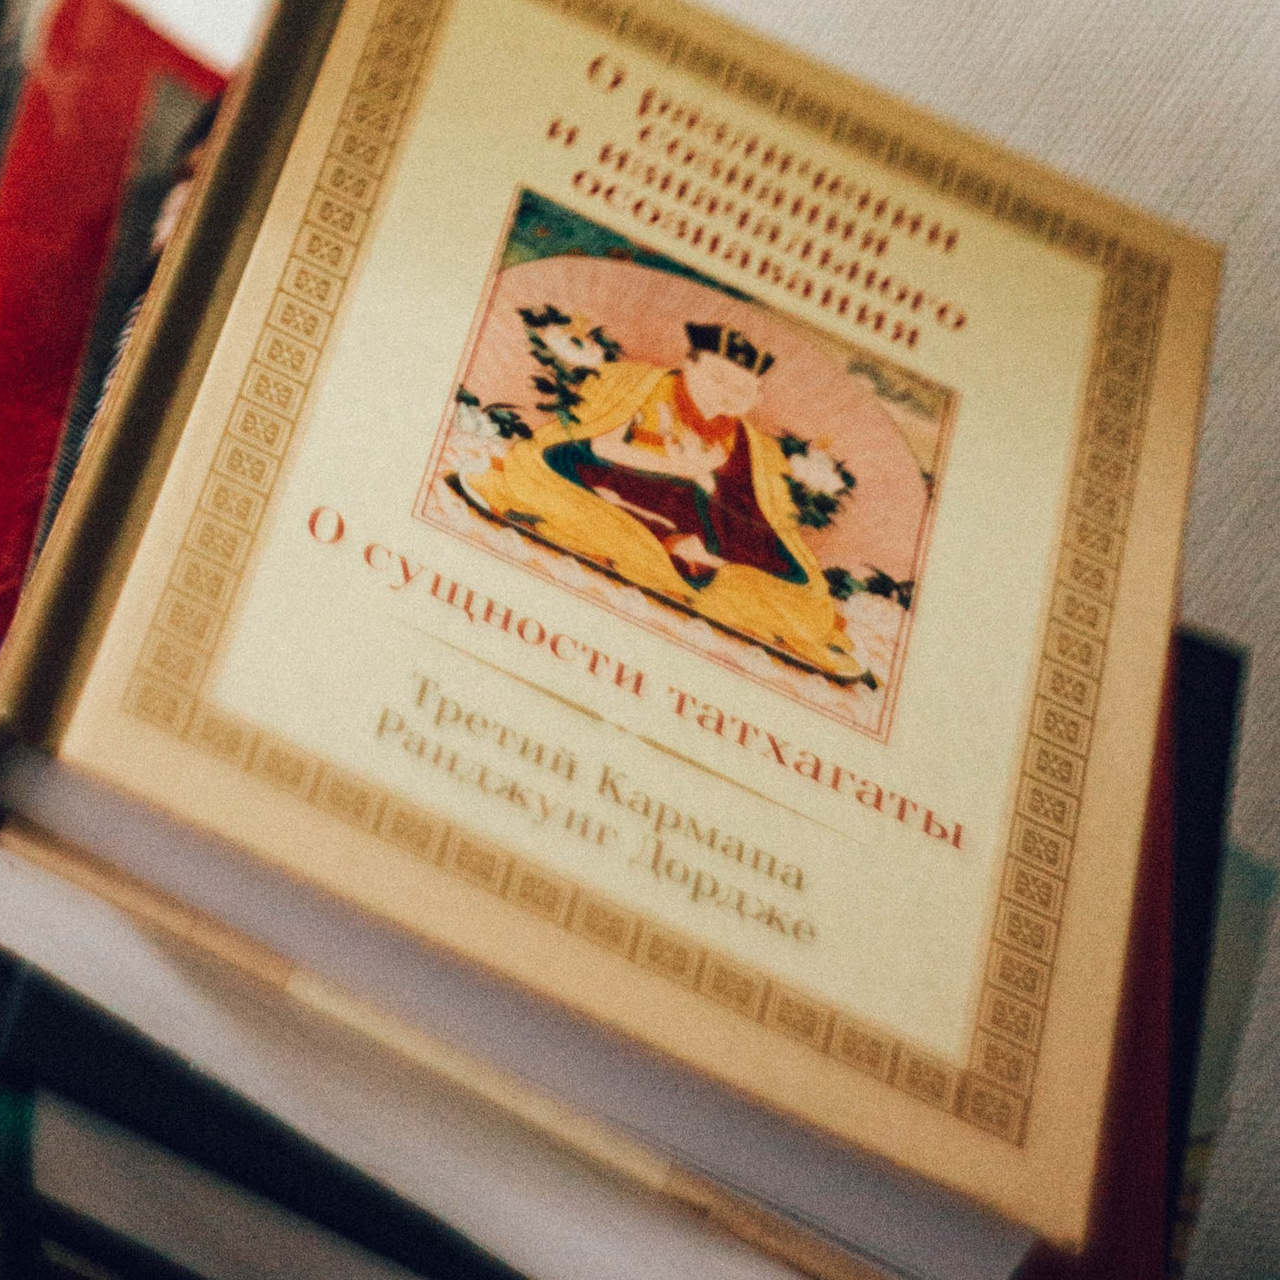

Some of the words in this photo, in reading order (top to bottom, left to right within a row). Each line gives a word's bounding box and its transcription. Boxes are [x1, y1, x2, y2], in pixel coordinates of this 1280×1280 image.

[587, 51, 626, 93] О
[308, 504, 344, 546] О
[364, 542, 645, 699] сущности
[667, 684, 968, 851] татхагаты
[409, 671, 581, 781] Третий
[596, 764, 810, 893] Кармапа
[373, 706, 624, 849] Ранджунг
[628, 836, 821, 947] Дордже
